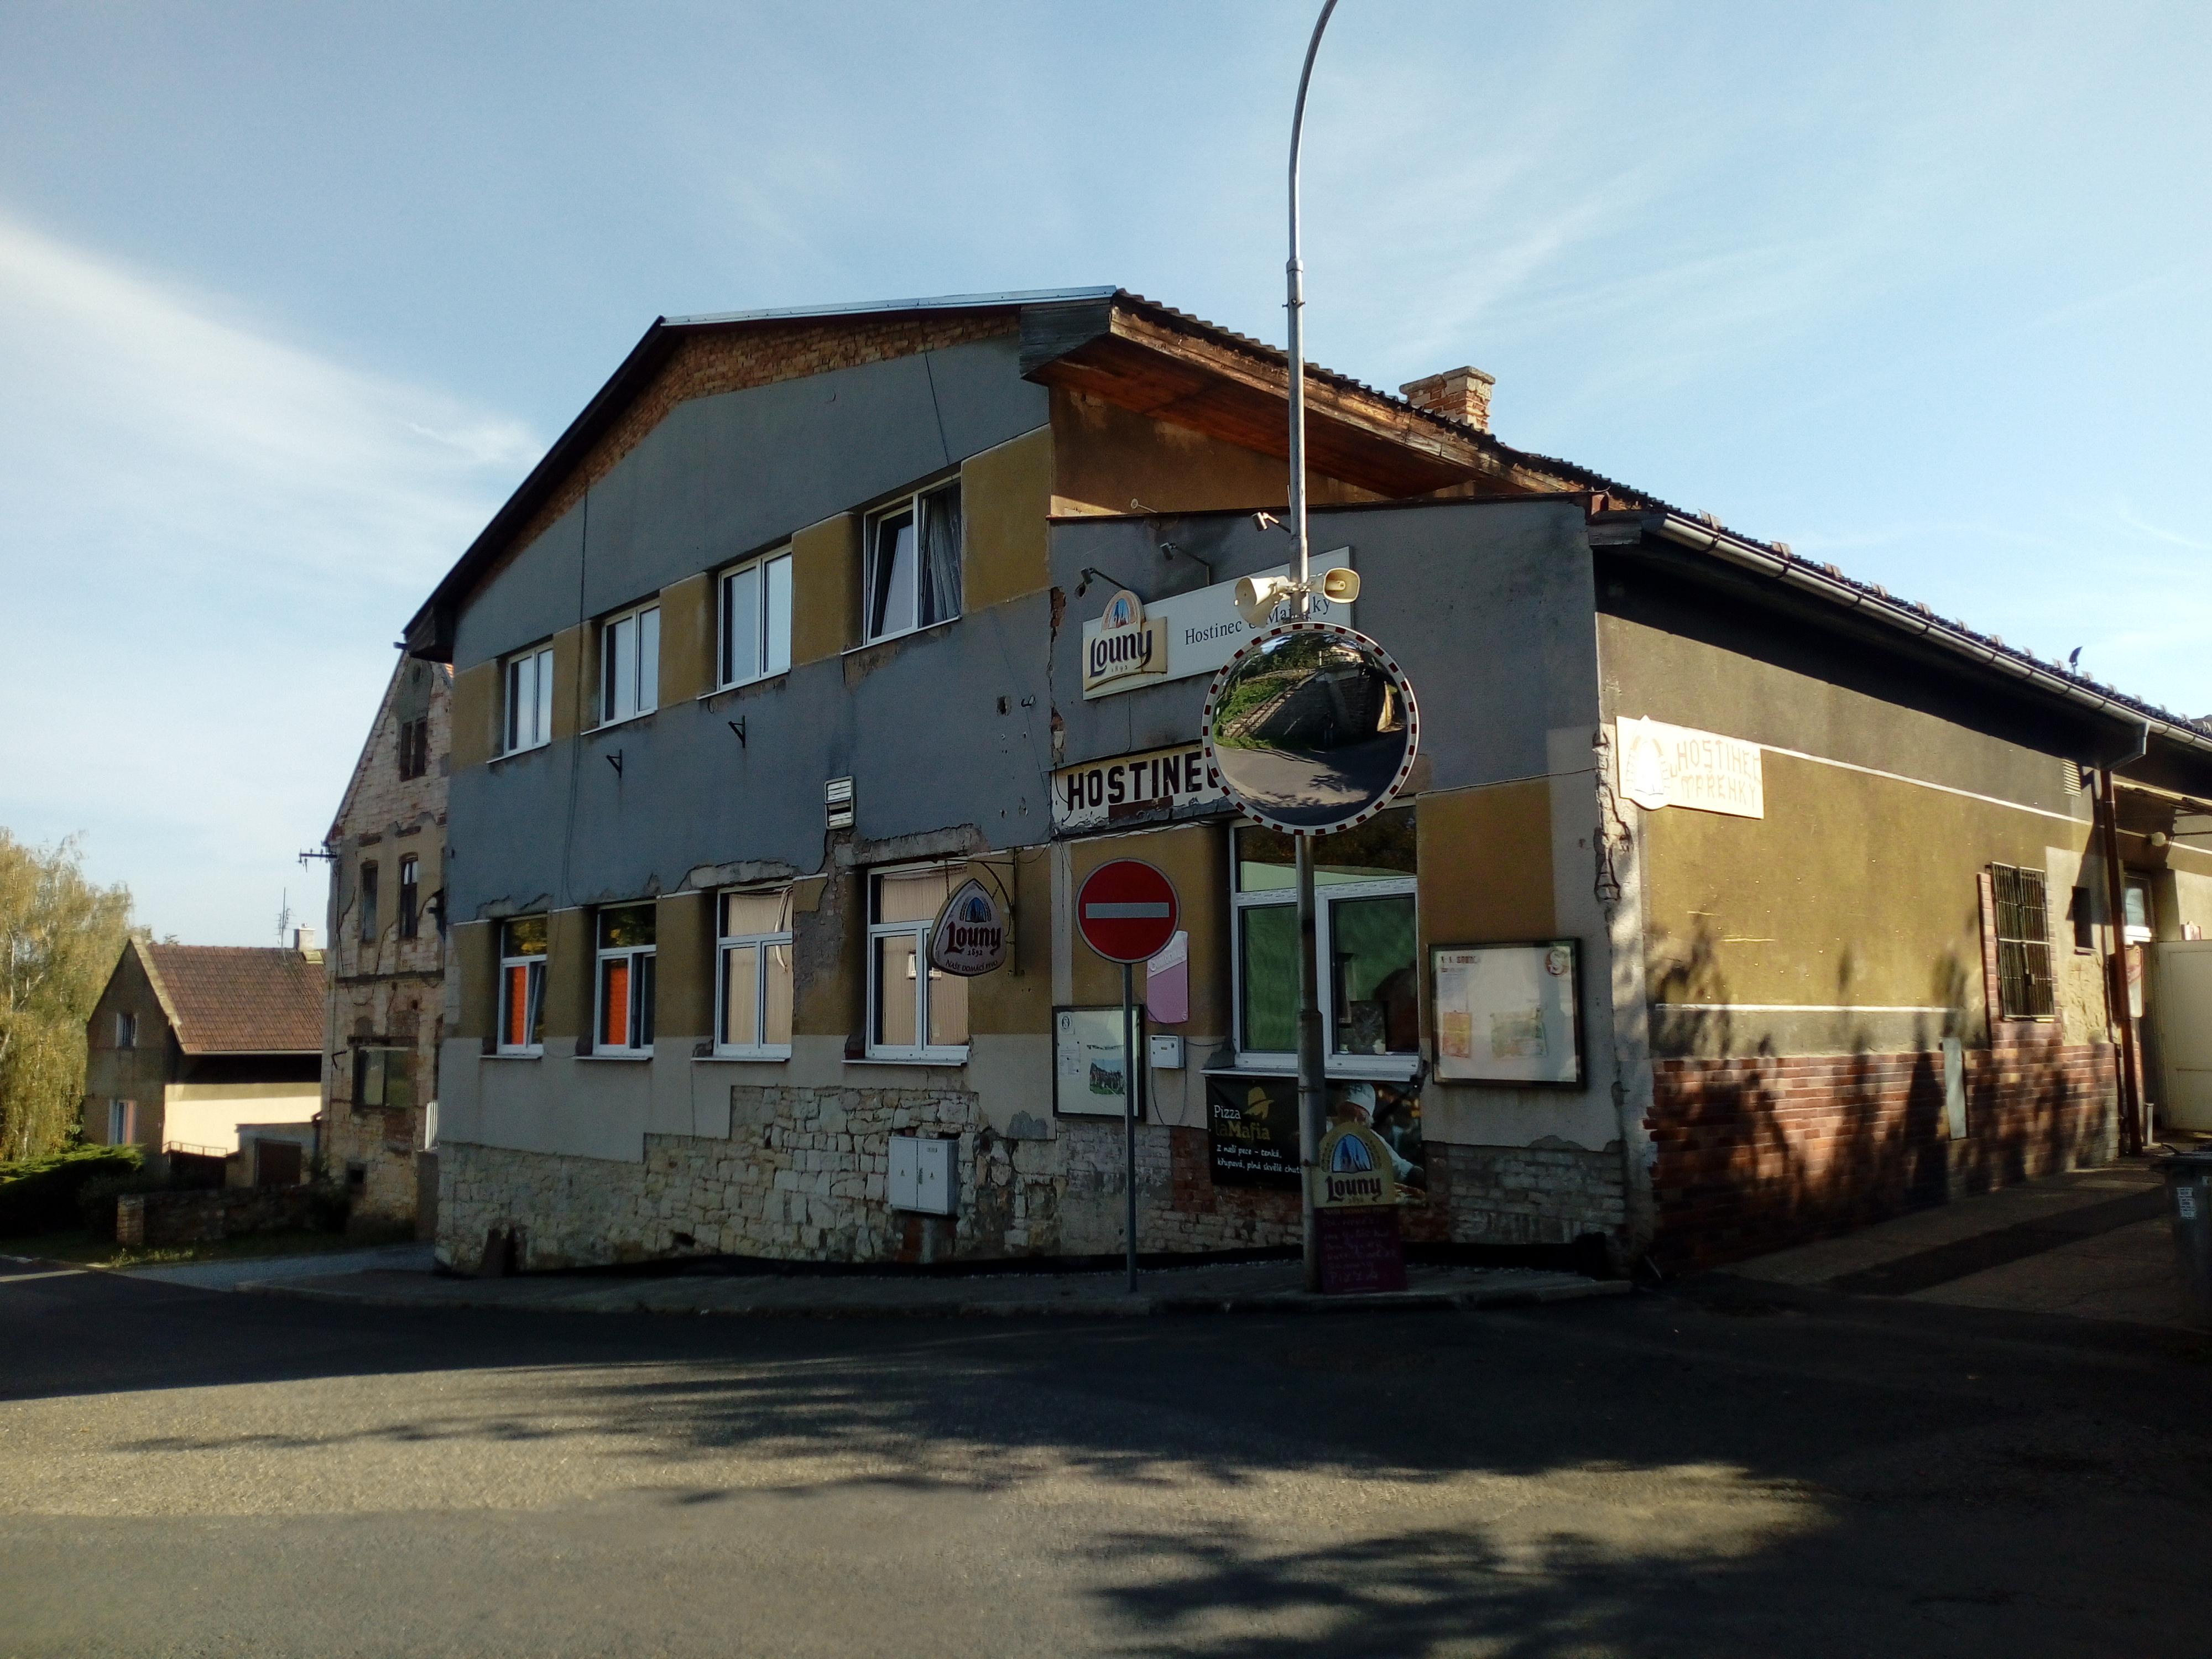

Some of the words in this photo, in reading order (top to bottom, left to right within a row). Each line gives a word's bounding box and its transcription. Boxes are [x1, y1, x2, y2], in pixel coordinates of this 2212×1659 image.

[1185, 620, 1243, 645] Hostinec
[1088, 630, 1152, 678] Louny
[944, 921, 1001, 956] Louny
[946, 959, 961, 971] NAŠE
[962, 962, 985, 972] DOMÁCÍ
[1213, 1104, 1241, 1119] Pizza
[1325, 1176, 1382, 1203] Louny
